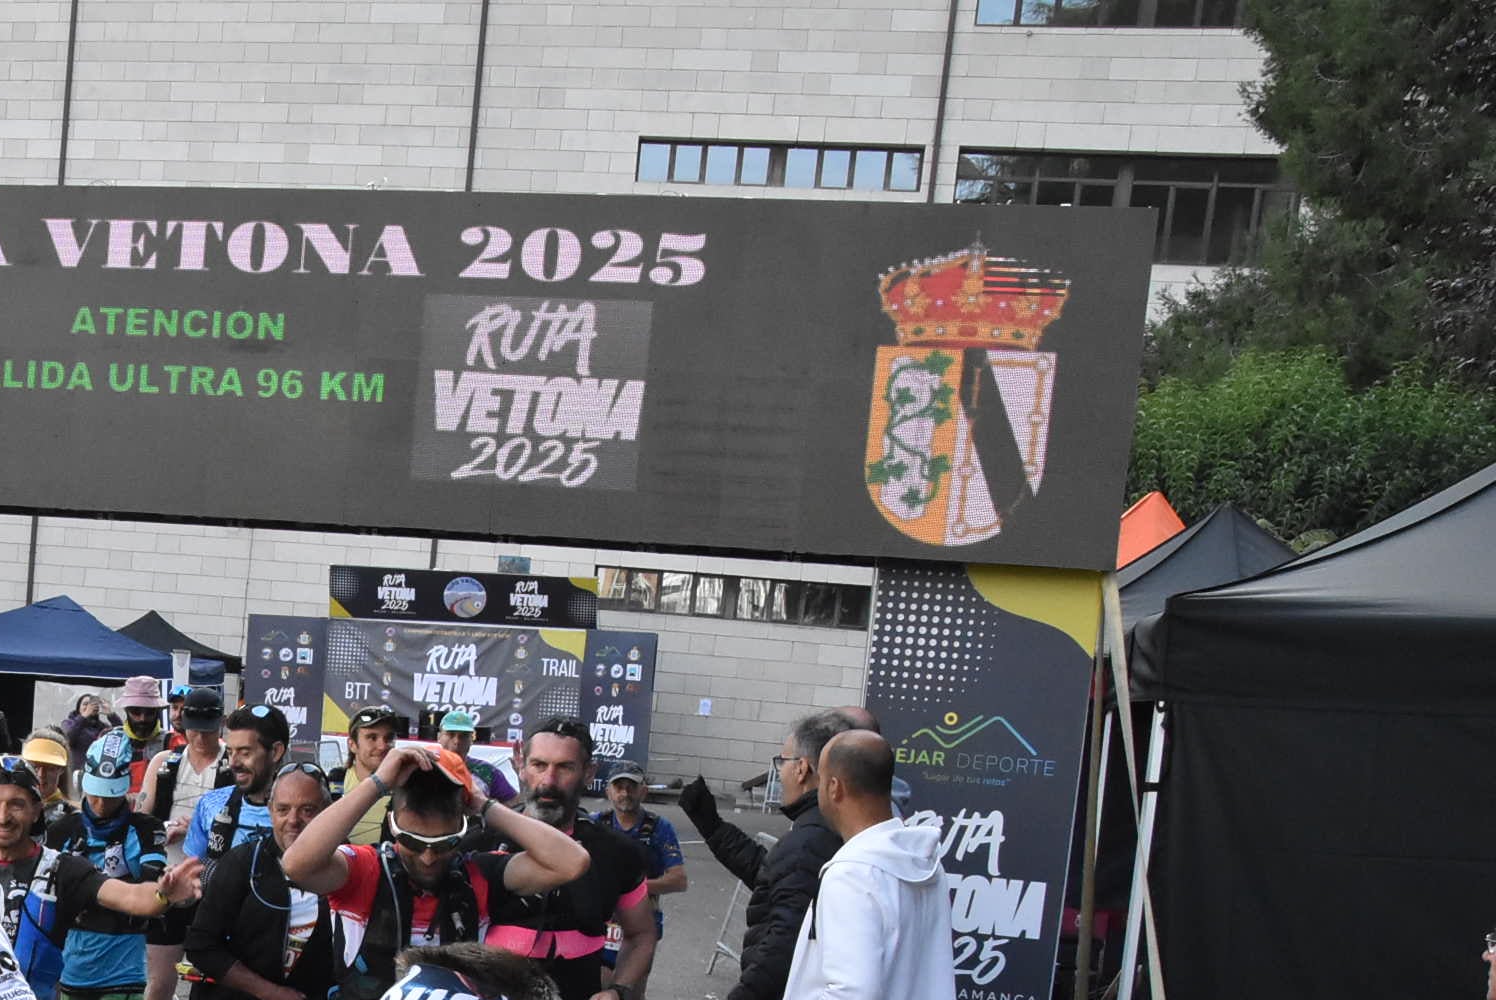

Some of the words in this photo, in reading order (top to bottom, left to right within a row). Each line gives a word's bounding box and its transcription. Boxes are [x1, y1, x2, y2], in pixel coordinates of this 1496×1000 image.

[40, 216, 425, 278] VETONA
[459, 225, 706, 287] 2025
[70, 305, 286, 342] ATENCION
[465, 300, 598, 377] RUTA
[109, 362, 243, 397] ULTRA
[257, 367, 304, 401] 96
[319, 370, 385, 404] KM
[433, 369, 645, 441] VETONA
[450, 437, 600, 488] 2025
[382, 573, 406, 588] RUTA
[515, 580, 539, 595] RUTA
[377, 586, 416, 602] VETONA
[509, 593, 549, 609] VETONA
[381, 600, 409, 612] 2025
[513, 606, 542, 618] 2025
[425, 643, 478, 676] RUTA
[541, 658, 580, 678] TRAIL
[264, 687, 295, 707] RUTA
[345, 681, 372, 701] BTT
[413, 672, 498, 707] VETONA
[596, 705, 623, 726] RUTA
[590, 723, 635, 745] VETONA
[592, 742, 625, 759] 2025
[956, 752, 1056, 777] DEPORTE
[952, 936, 1010, 985] 25
